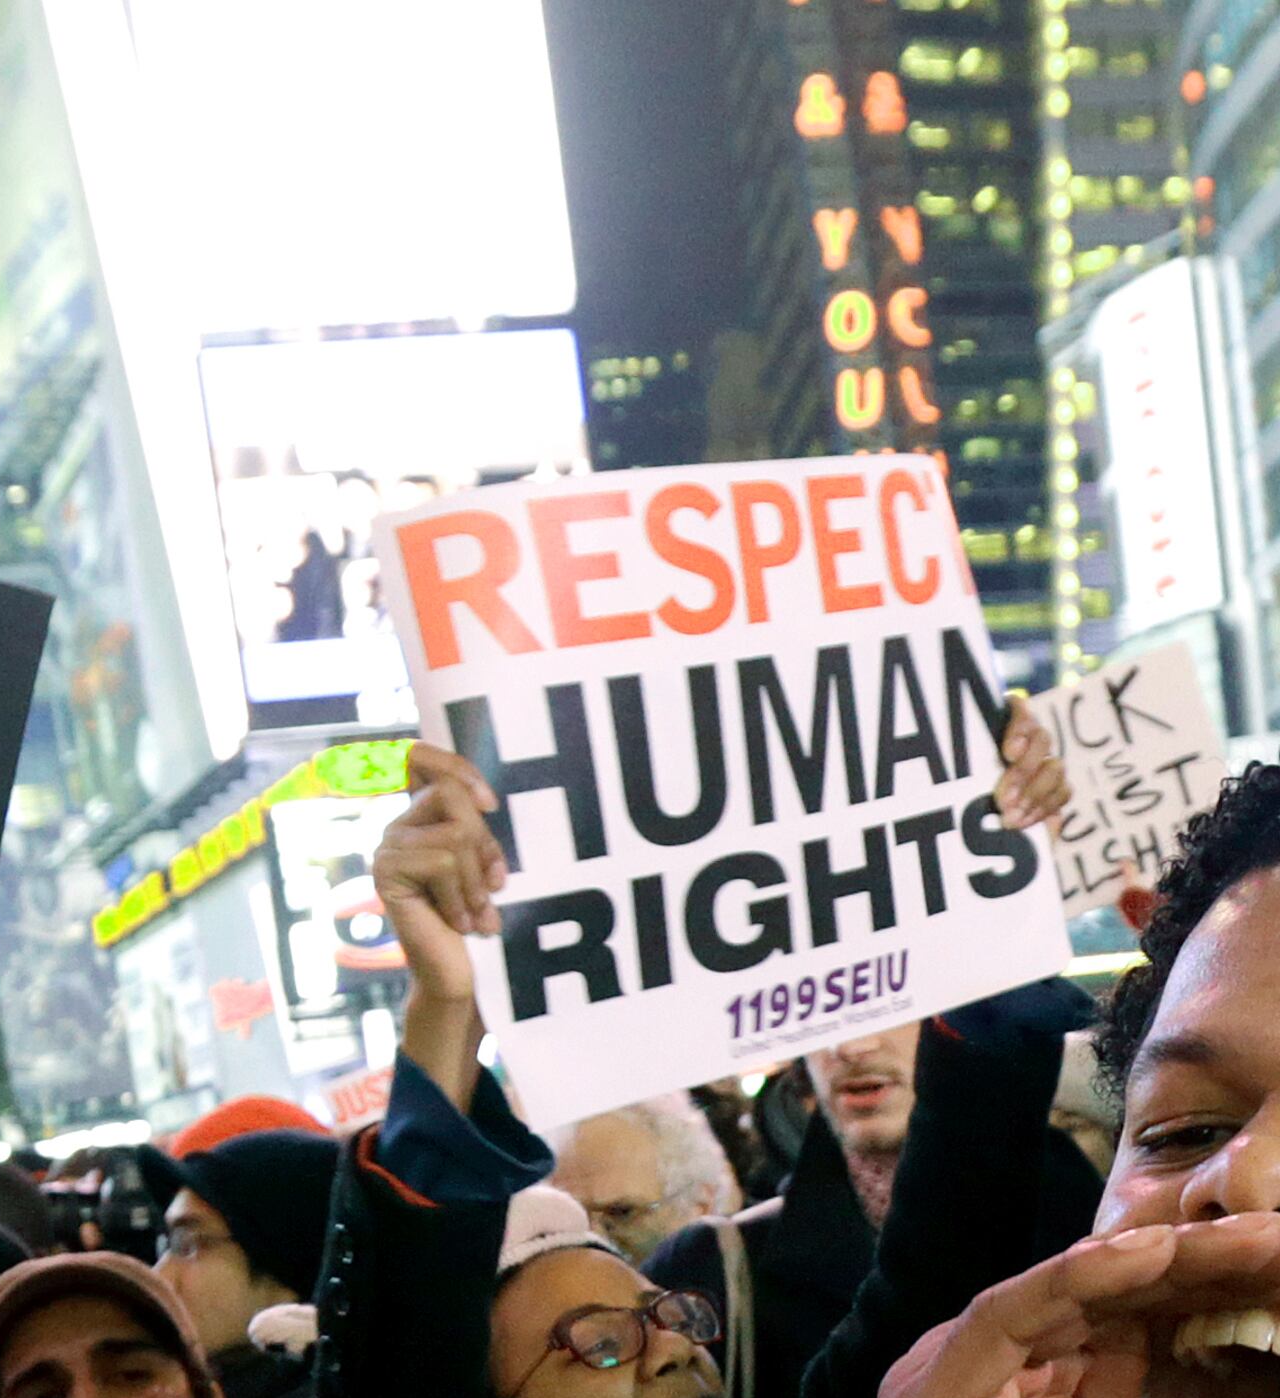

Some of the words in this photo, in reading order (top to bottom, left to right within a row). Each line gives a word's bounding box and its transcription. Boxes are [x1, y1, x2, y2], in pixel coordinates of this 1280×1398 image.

[812, 207, 897, 456] YOU
[445, 626, 1012, 873] HUMAN
[497, 790, 1040, 1022] RIGHTS
[727, 949, 908, 1038] 1199SEIU
